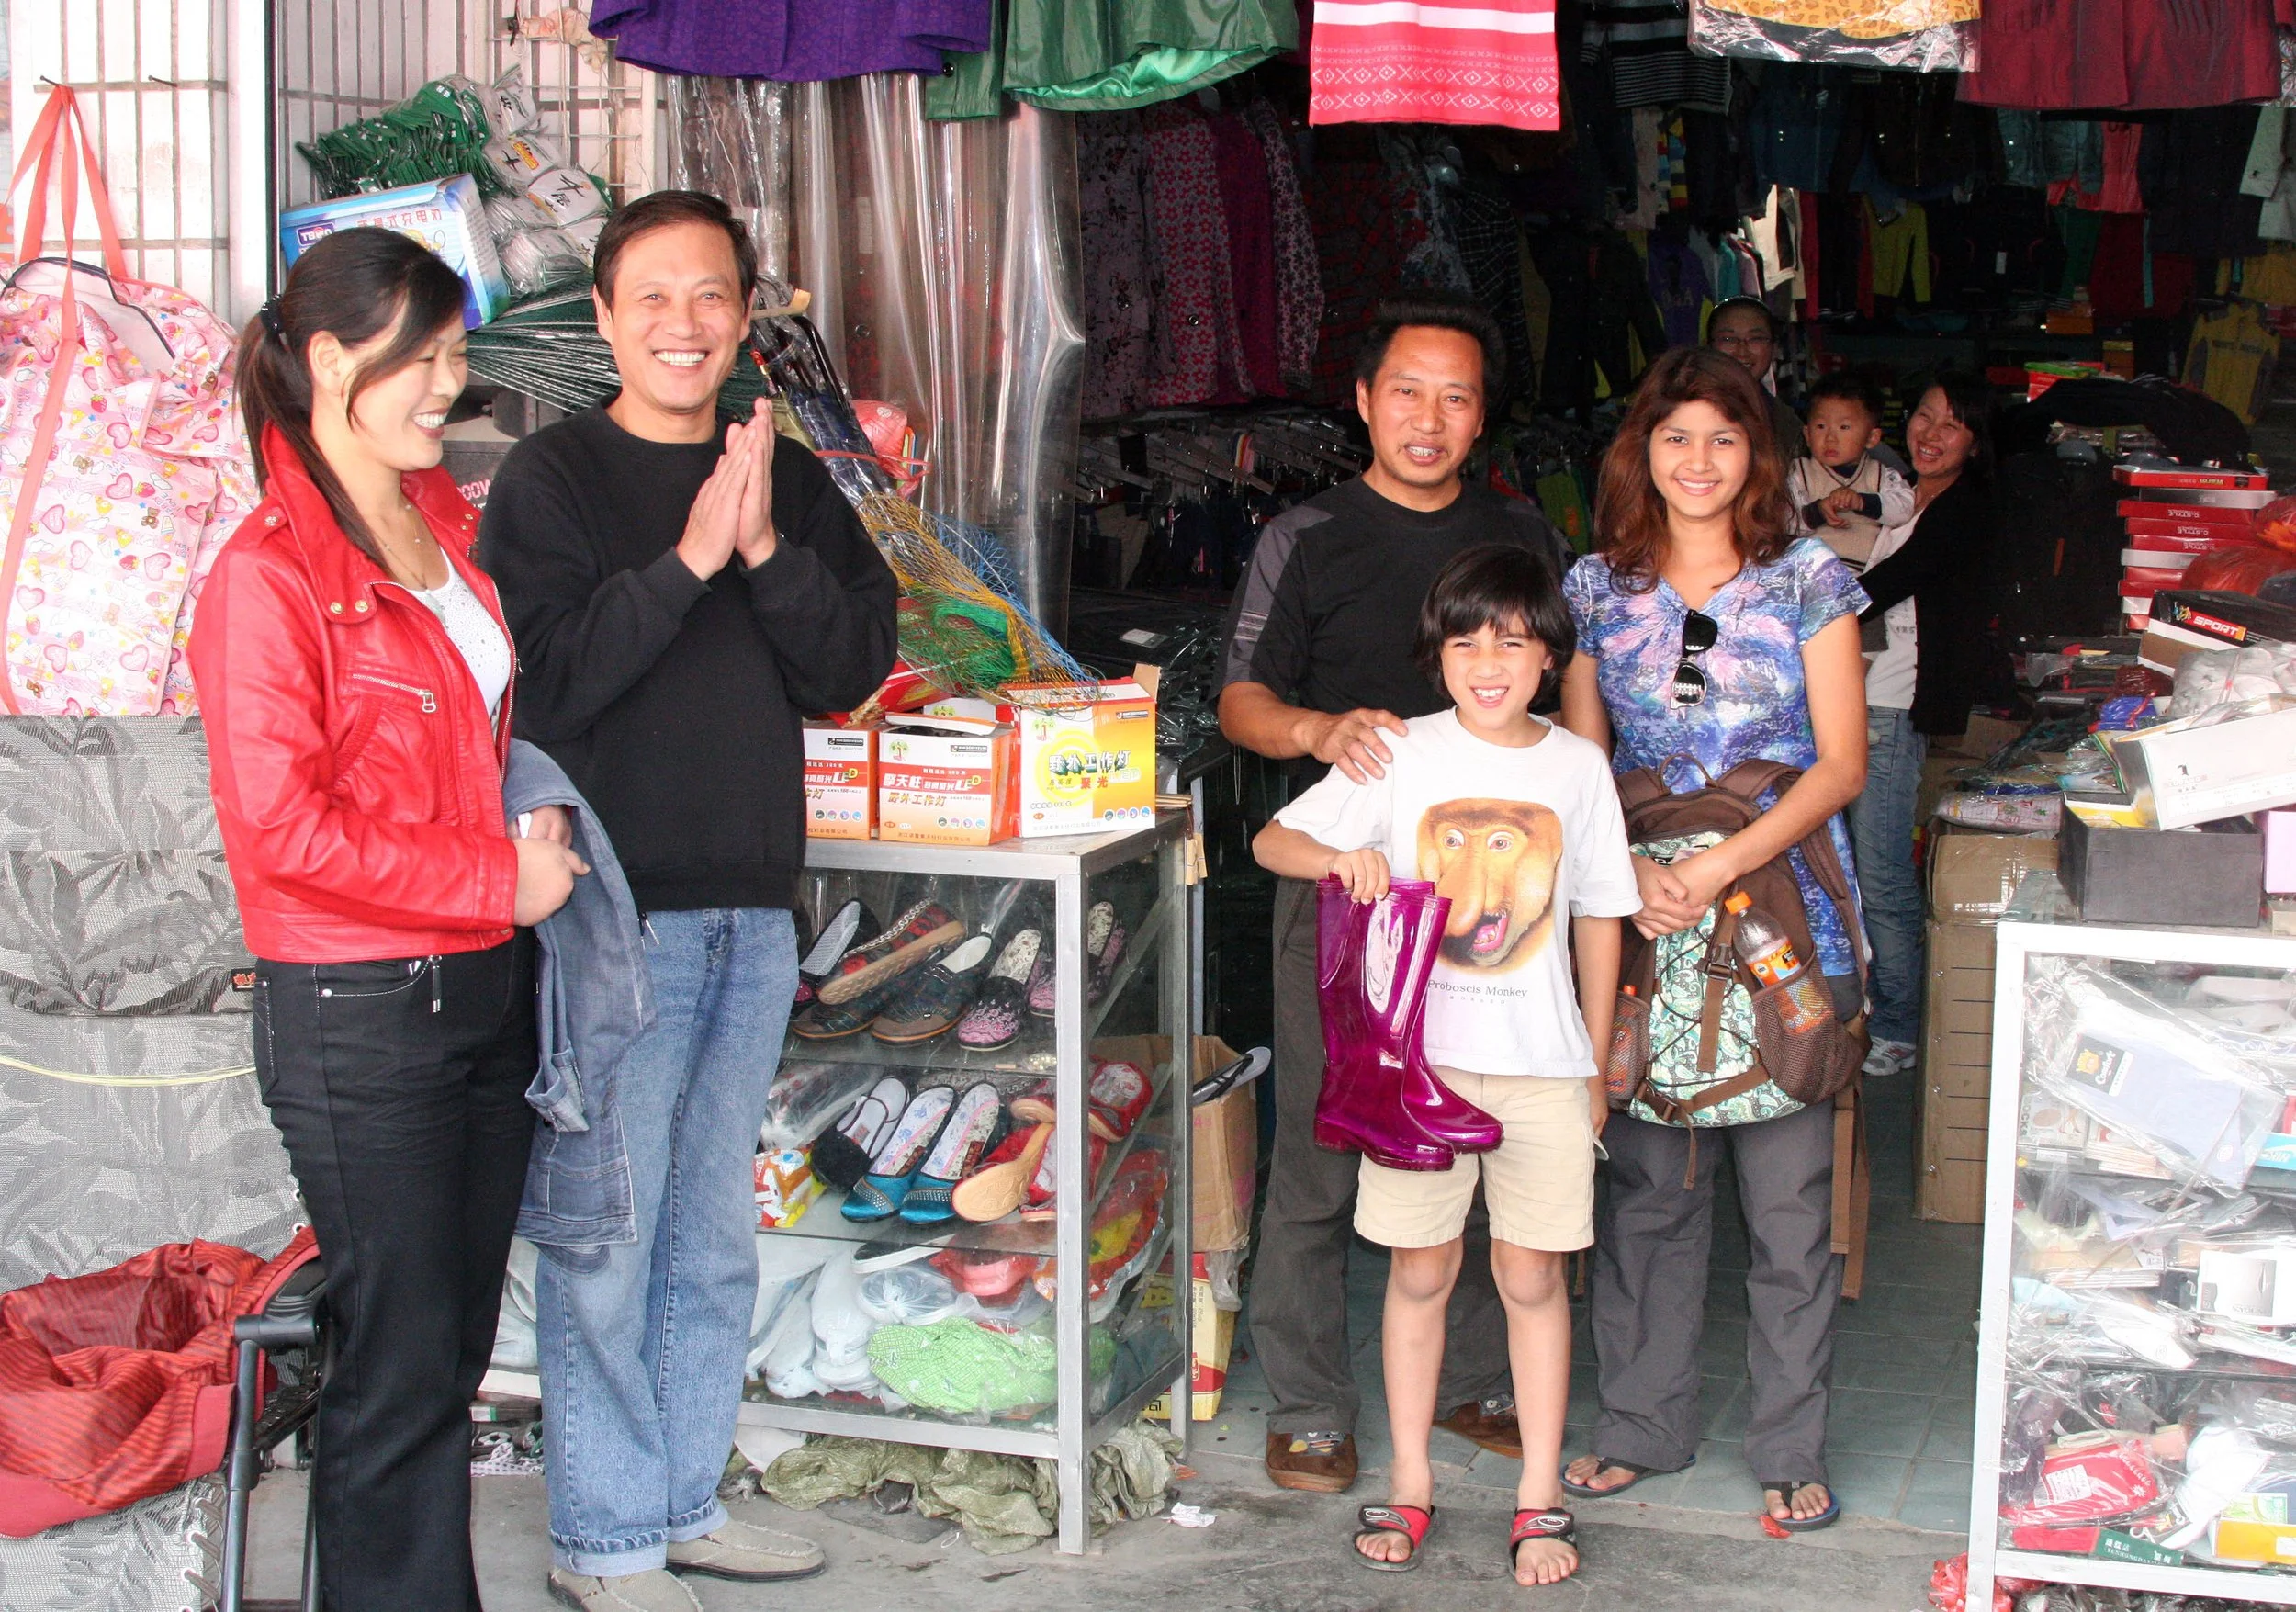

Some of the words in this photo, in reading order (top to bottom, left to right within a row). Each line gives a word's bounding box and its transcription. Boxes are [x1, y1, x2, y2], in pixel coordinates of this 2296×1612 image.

[2193, 615, 2239, 636] SPORT
[1049, 750, 1131, 776] 野外工作灯
[832, 768, 859, 783] LED
[955, 775, 982, 791] LED
[888, 792, 947, 807] 野外工作灯
[1428, 979, 1481, 994] Proboscis
[1485, 986, 1528, 998] Monkey
